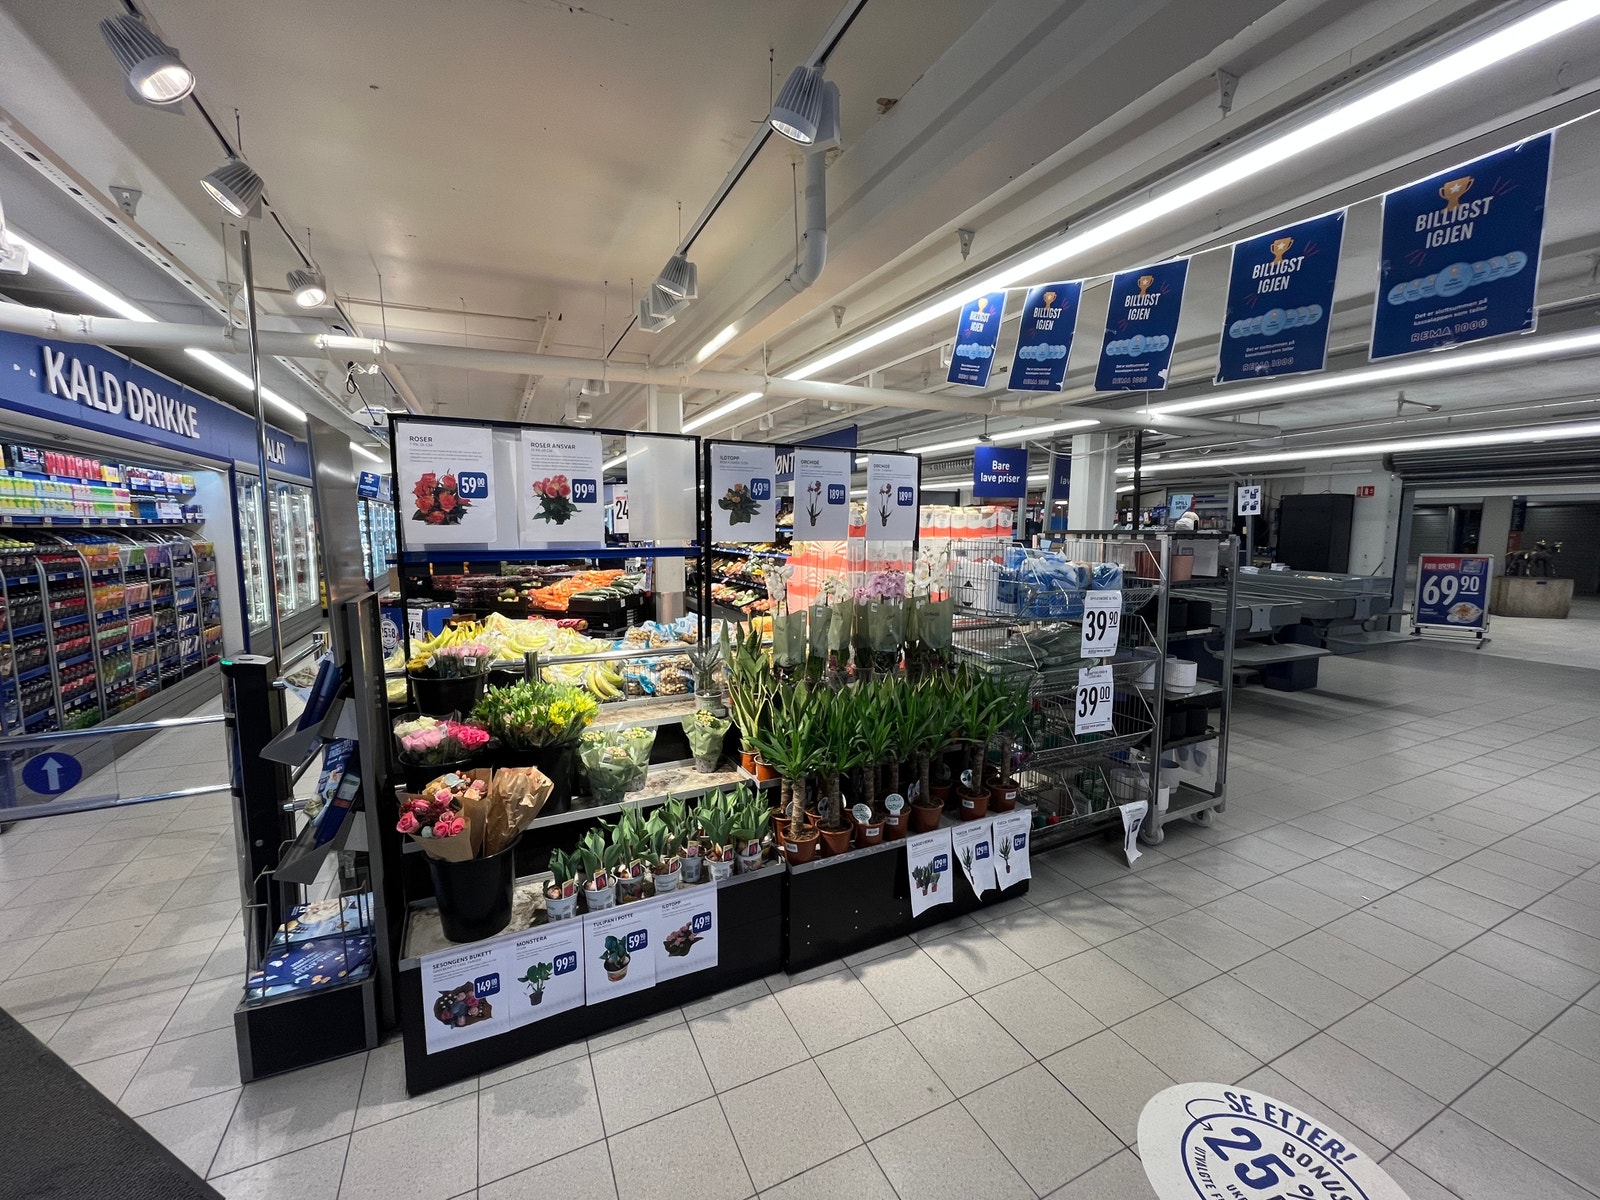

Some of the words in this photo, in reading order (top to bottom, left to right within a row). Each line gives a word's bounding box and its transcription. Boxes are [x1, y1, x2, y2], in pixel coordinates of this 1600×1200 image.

[1415, 196, 1494, 232] BILLIGST
[1425, 222, 1474, 249] IGJEN
[1252, 256, 1305, 279] BILLIGST
[1257, 275, 1290, 294] IGJEN
[1124, 293, 1161, 308] BILLIGST
[1033, 307, 1063, 319] BILLIGST
[1127, 308, 1151, 321] IGJEN
[1036, 319, 1055, 331] IGJEN
[1411, 326, 1451, 343] REMA
[1454, 318, 1488, 333] 1000
[1242, 361, 1269, 372] REMA
[1272, 357, 1294, 368] 1000
[43, 345, 123, 414] KALD
[126, 380, 200, 440] DRIKKE
[266, 437, 286, 465] ALAT
[775, 452, 796, 475] ØNT
[992, 460, 1010, 471] Bare
[980, 472, 997, 482] lave
[998, 473, 1020, 485] priser
[1060, 476, 1070, 485] lav
[662, 900, 682, 909] ILDTOPP
[593, 917, 615, 927] TULIPAN
[618, 912, 634, 921] POTTE
[516, 936, 548, 948] MONSTERA
[432, 954, 468, 970] SESONGENS
[468, 949, 493, 961] BUKETT
[1224, 1091, 1258, 1117] SE
[1264, 1102, 1358, 1165] ETTER!
[1194, 1146, 1216, 1190] UTVALGTE
